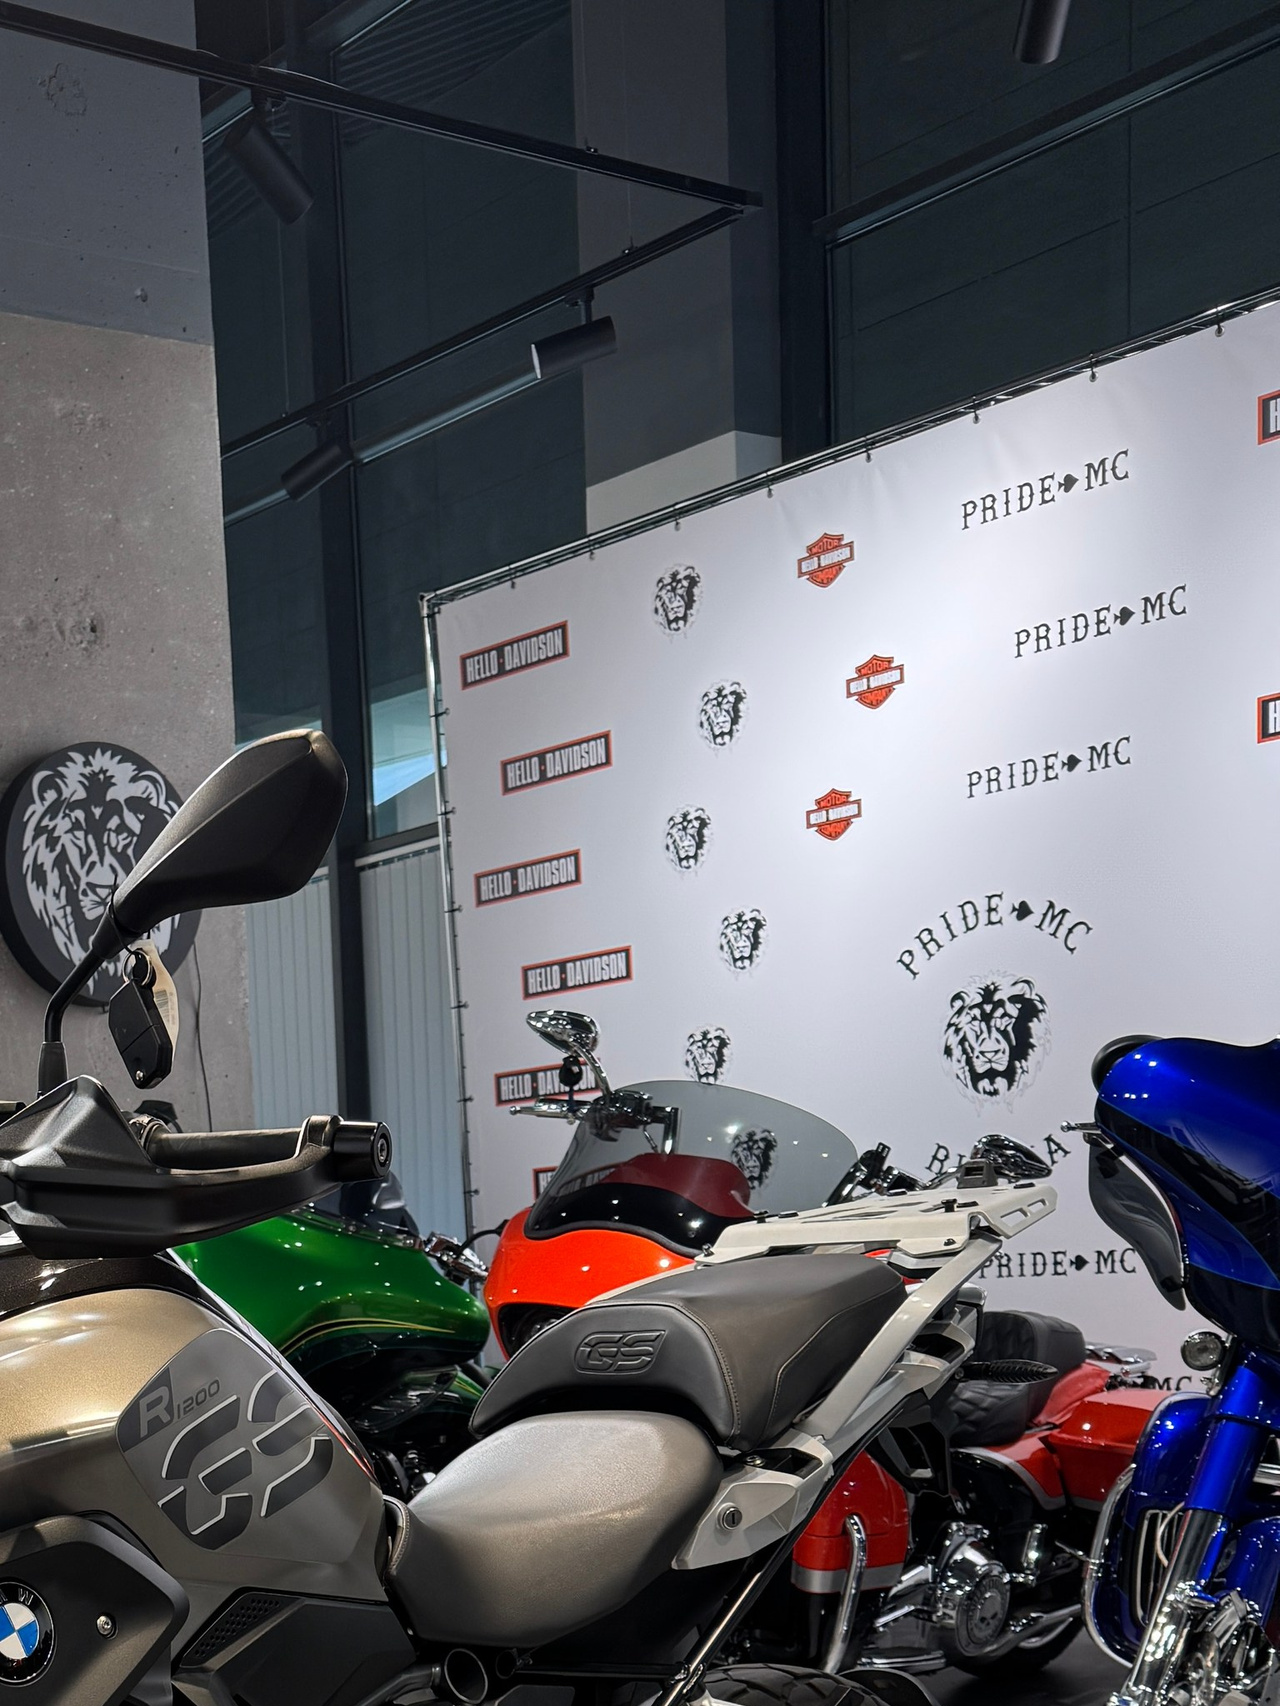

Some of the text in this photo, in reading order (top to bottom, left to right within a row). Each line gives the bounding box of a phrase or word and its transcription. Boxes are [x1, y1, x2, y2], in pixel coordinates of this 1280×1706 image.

[962, 448, 1129, 530] PRIDE MC
[1015, 584, 1187, 658] PRIDE MC
[466, 628, 563, 683] HELLO DAVIDSON
[506, 738, 606, 788] HELLO DAVIDSON
[967, 735, 1131, 798] PRIDE MC
[480, 856, 576, 901] HELLO DAVIDSON
[896, 891, 1093, 980] PRIDE MC
[527, 952, 626, 994] HELLO DAVIDSON
[500, 1065, 596, 1100] HELLO DAVON
[1094, 1248, 1136, 1274] MC
[578, 1331, 665, 1372] GS
[139, 1379, 220, 1438] R 1200
